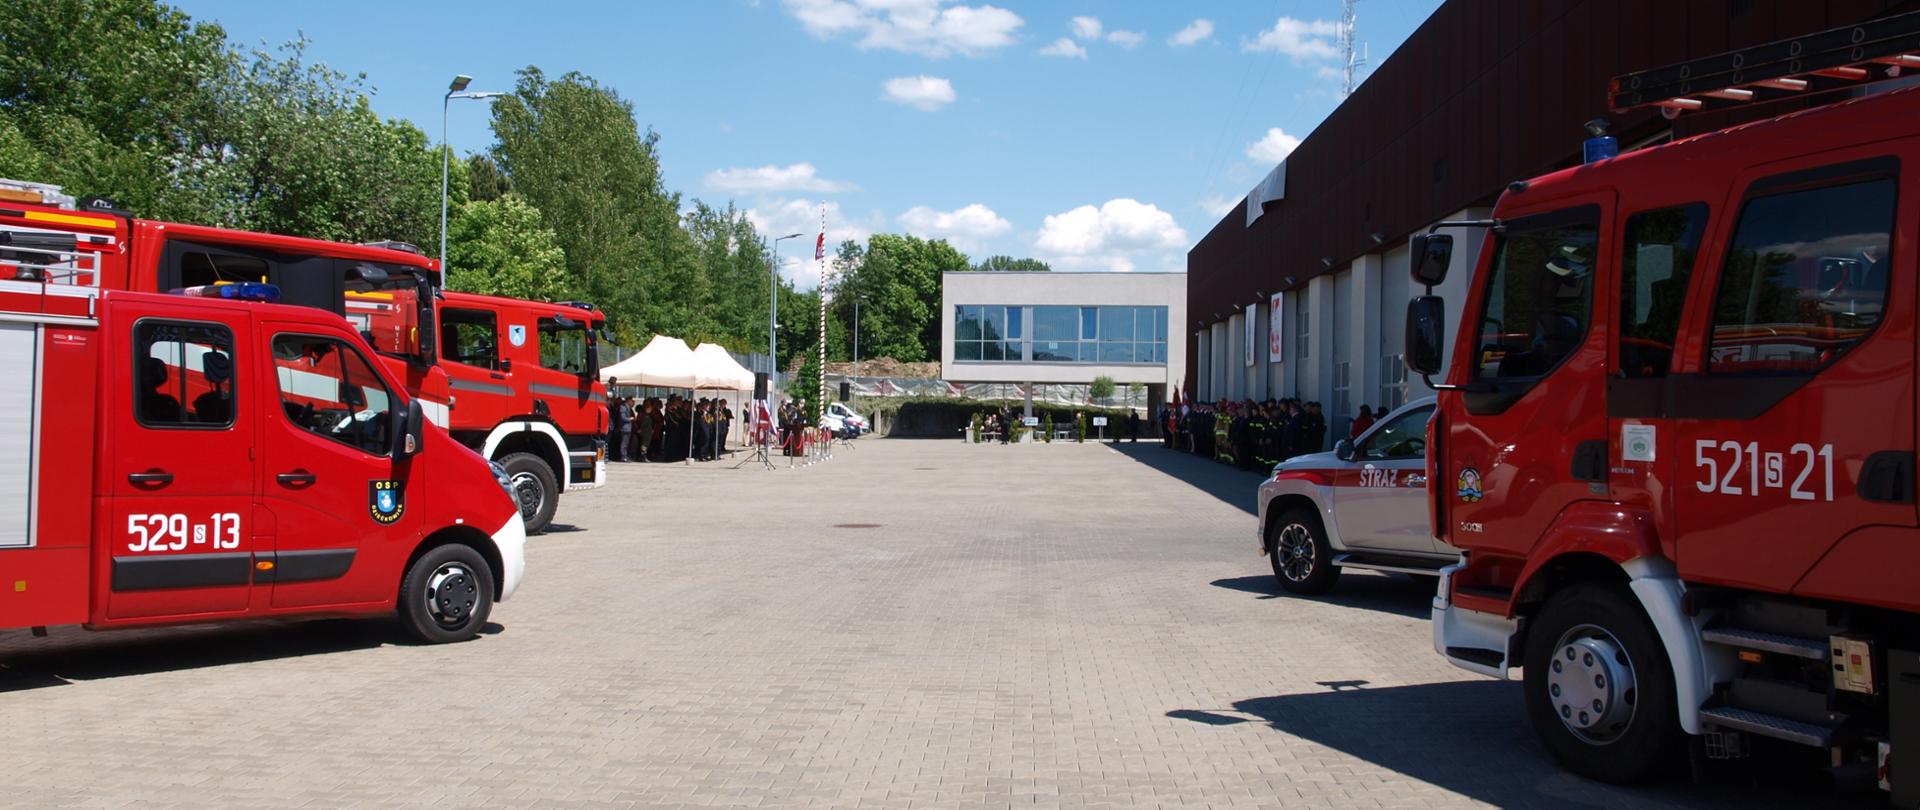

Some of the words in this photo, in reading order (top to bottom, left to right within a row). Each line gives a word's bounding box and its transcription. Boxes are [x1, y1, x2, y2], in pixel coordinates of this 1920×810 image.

[376, 481, 399, 489] OSP
[1696, 439, 1759, 496] 521
[1767, 454, 1781, 485] S
[1790, 443, 1834, 501] 21
[127, 513, 188, 552] 529
[195, 526, 205, 542] S
[210, 512, 241, 549] 13
